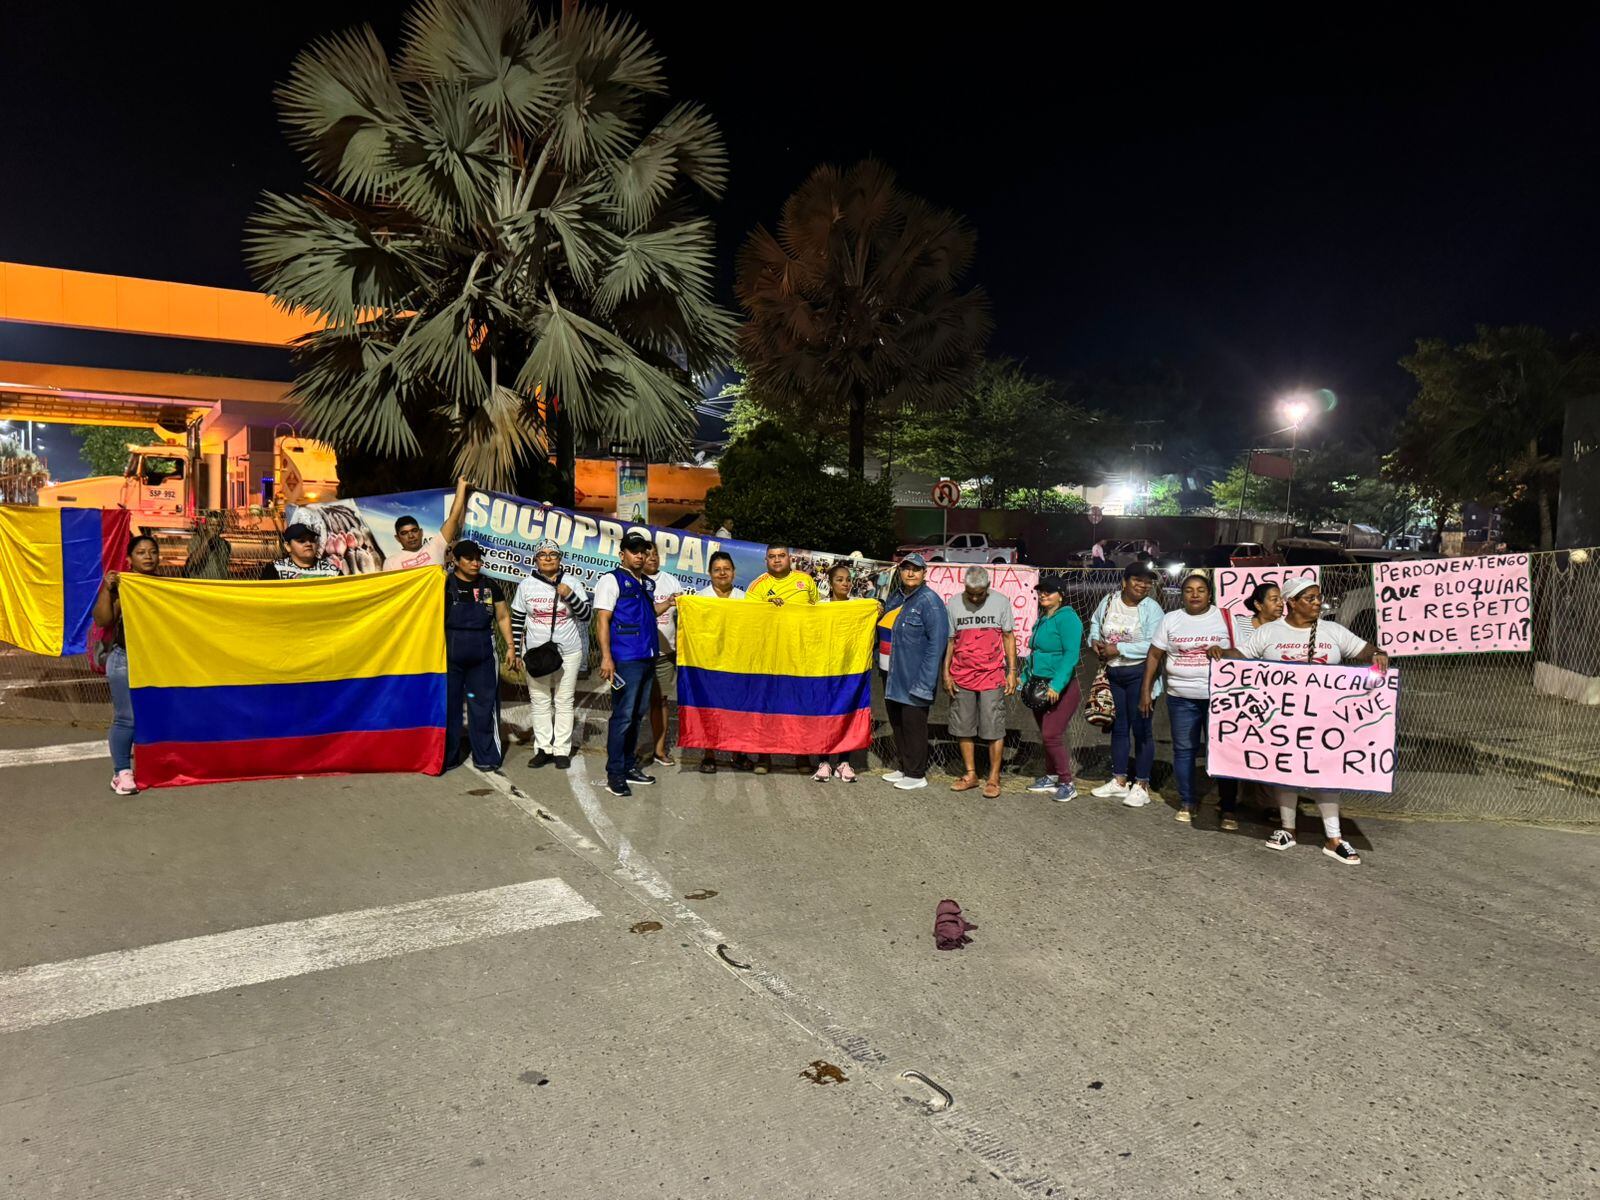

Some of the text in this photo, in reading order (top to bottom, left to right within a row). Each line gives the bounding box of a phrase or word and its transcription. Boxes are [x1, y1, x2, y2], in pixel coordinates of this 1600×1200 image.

[572, 553, 621, 568] PRODUCTO
[957, 616, 973, 625] JUST
[1382, 596, 1530, 622] EL RESPETO
[1381, 617, 1530, 646] DONDE ESTA?
[1214, 661, 1298, 688] SEÑOR
[1211, 691, 1259, 714] ESTA
[1281, 692, 1317, 717] EL
[1218, 720, 1345, 750] PASEO
[1244, 749, 1319, 774] DEL
